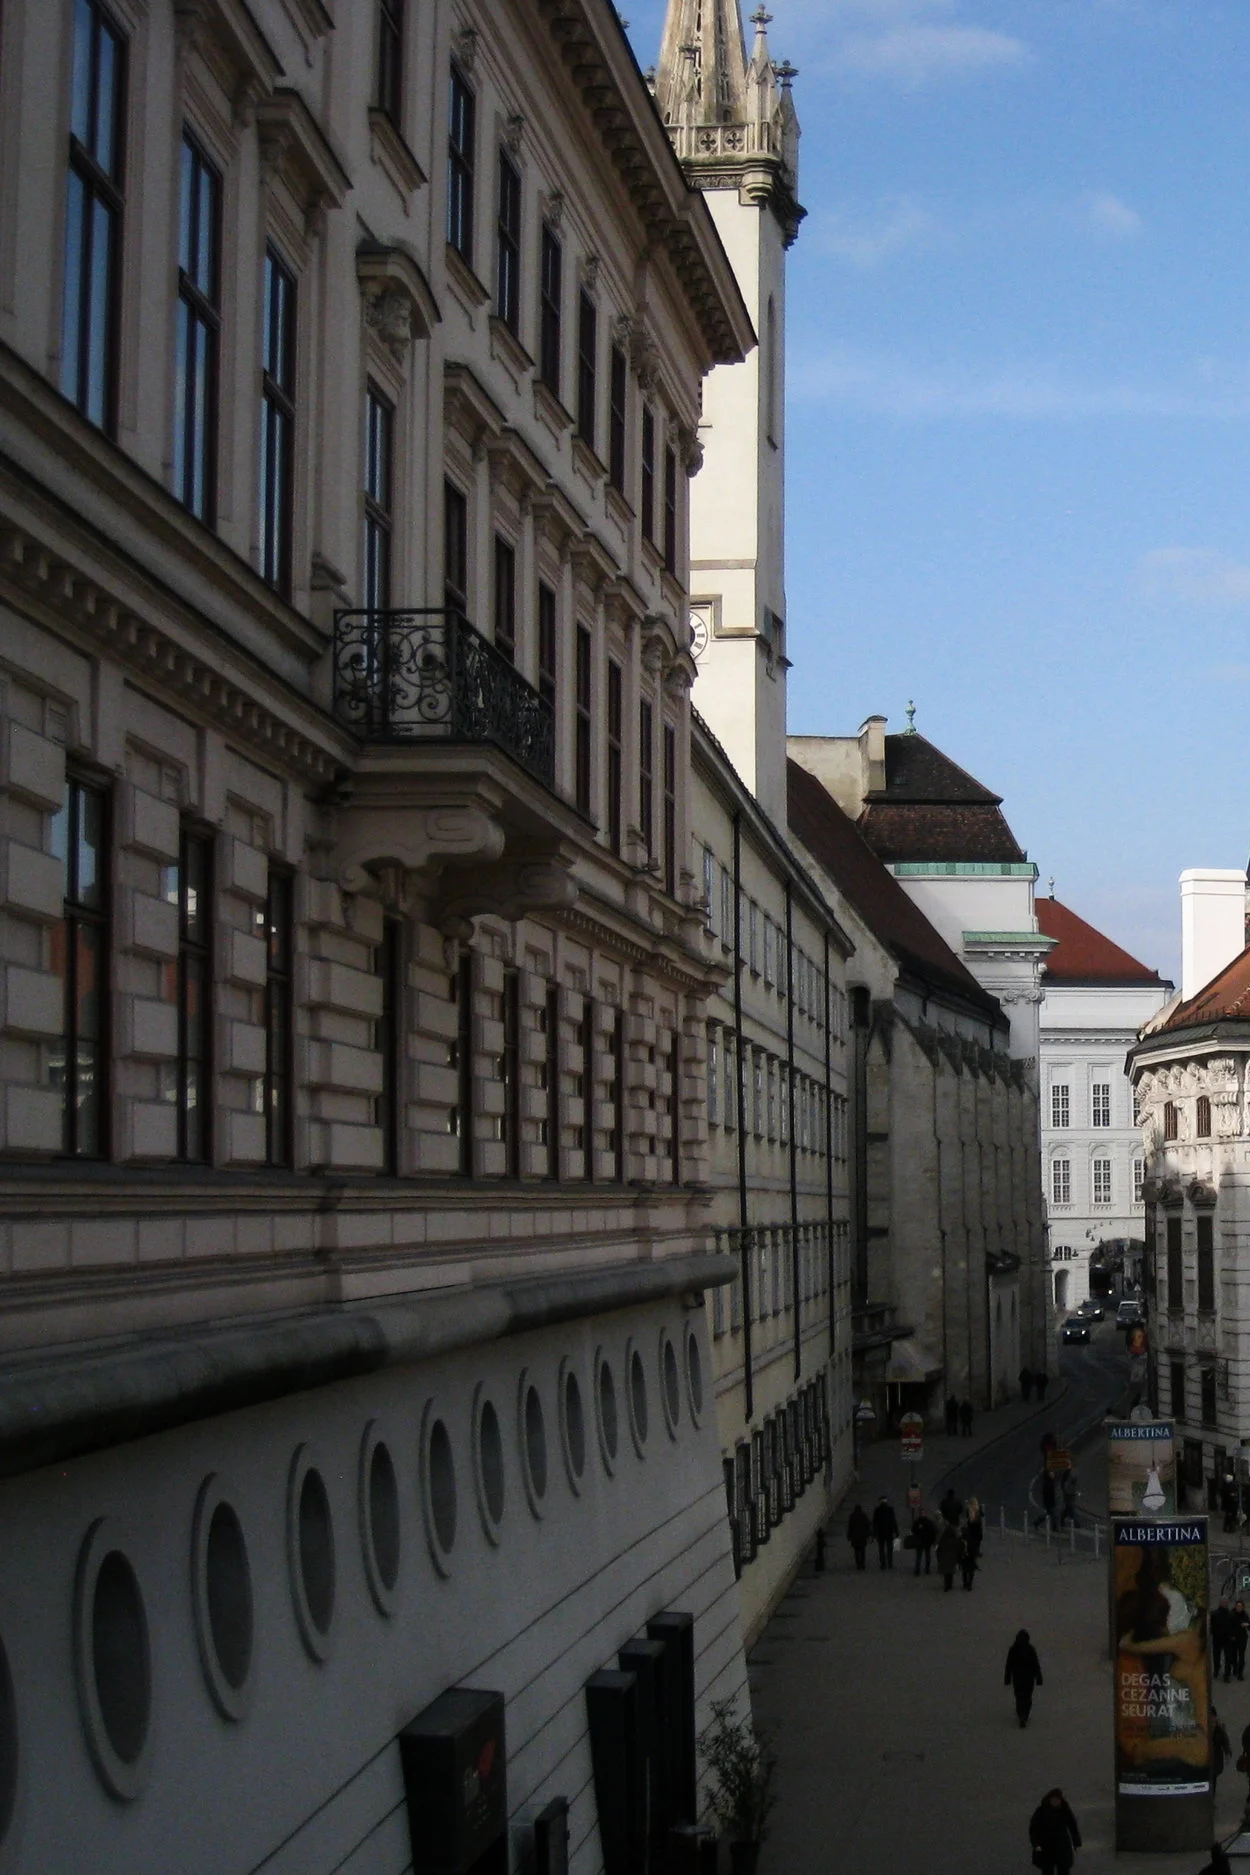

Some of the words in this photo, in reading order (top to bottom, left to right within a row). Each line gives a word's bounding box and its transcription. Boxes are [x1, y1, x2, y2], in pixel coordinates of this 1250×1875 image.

[1111, 1427, 1170, 1438] ALBERTINA
[1120, 1527, 1201, 1541] ALBERTINA
[1122, 1673, 1171, 1687] DEGAS
[1122, 1688, 1190, 1702] CEZANNE
[1122, 1703, 1178, 1718] SEURAT
